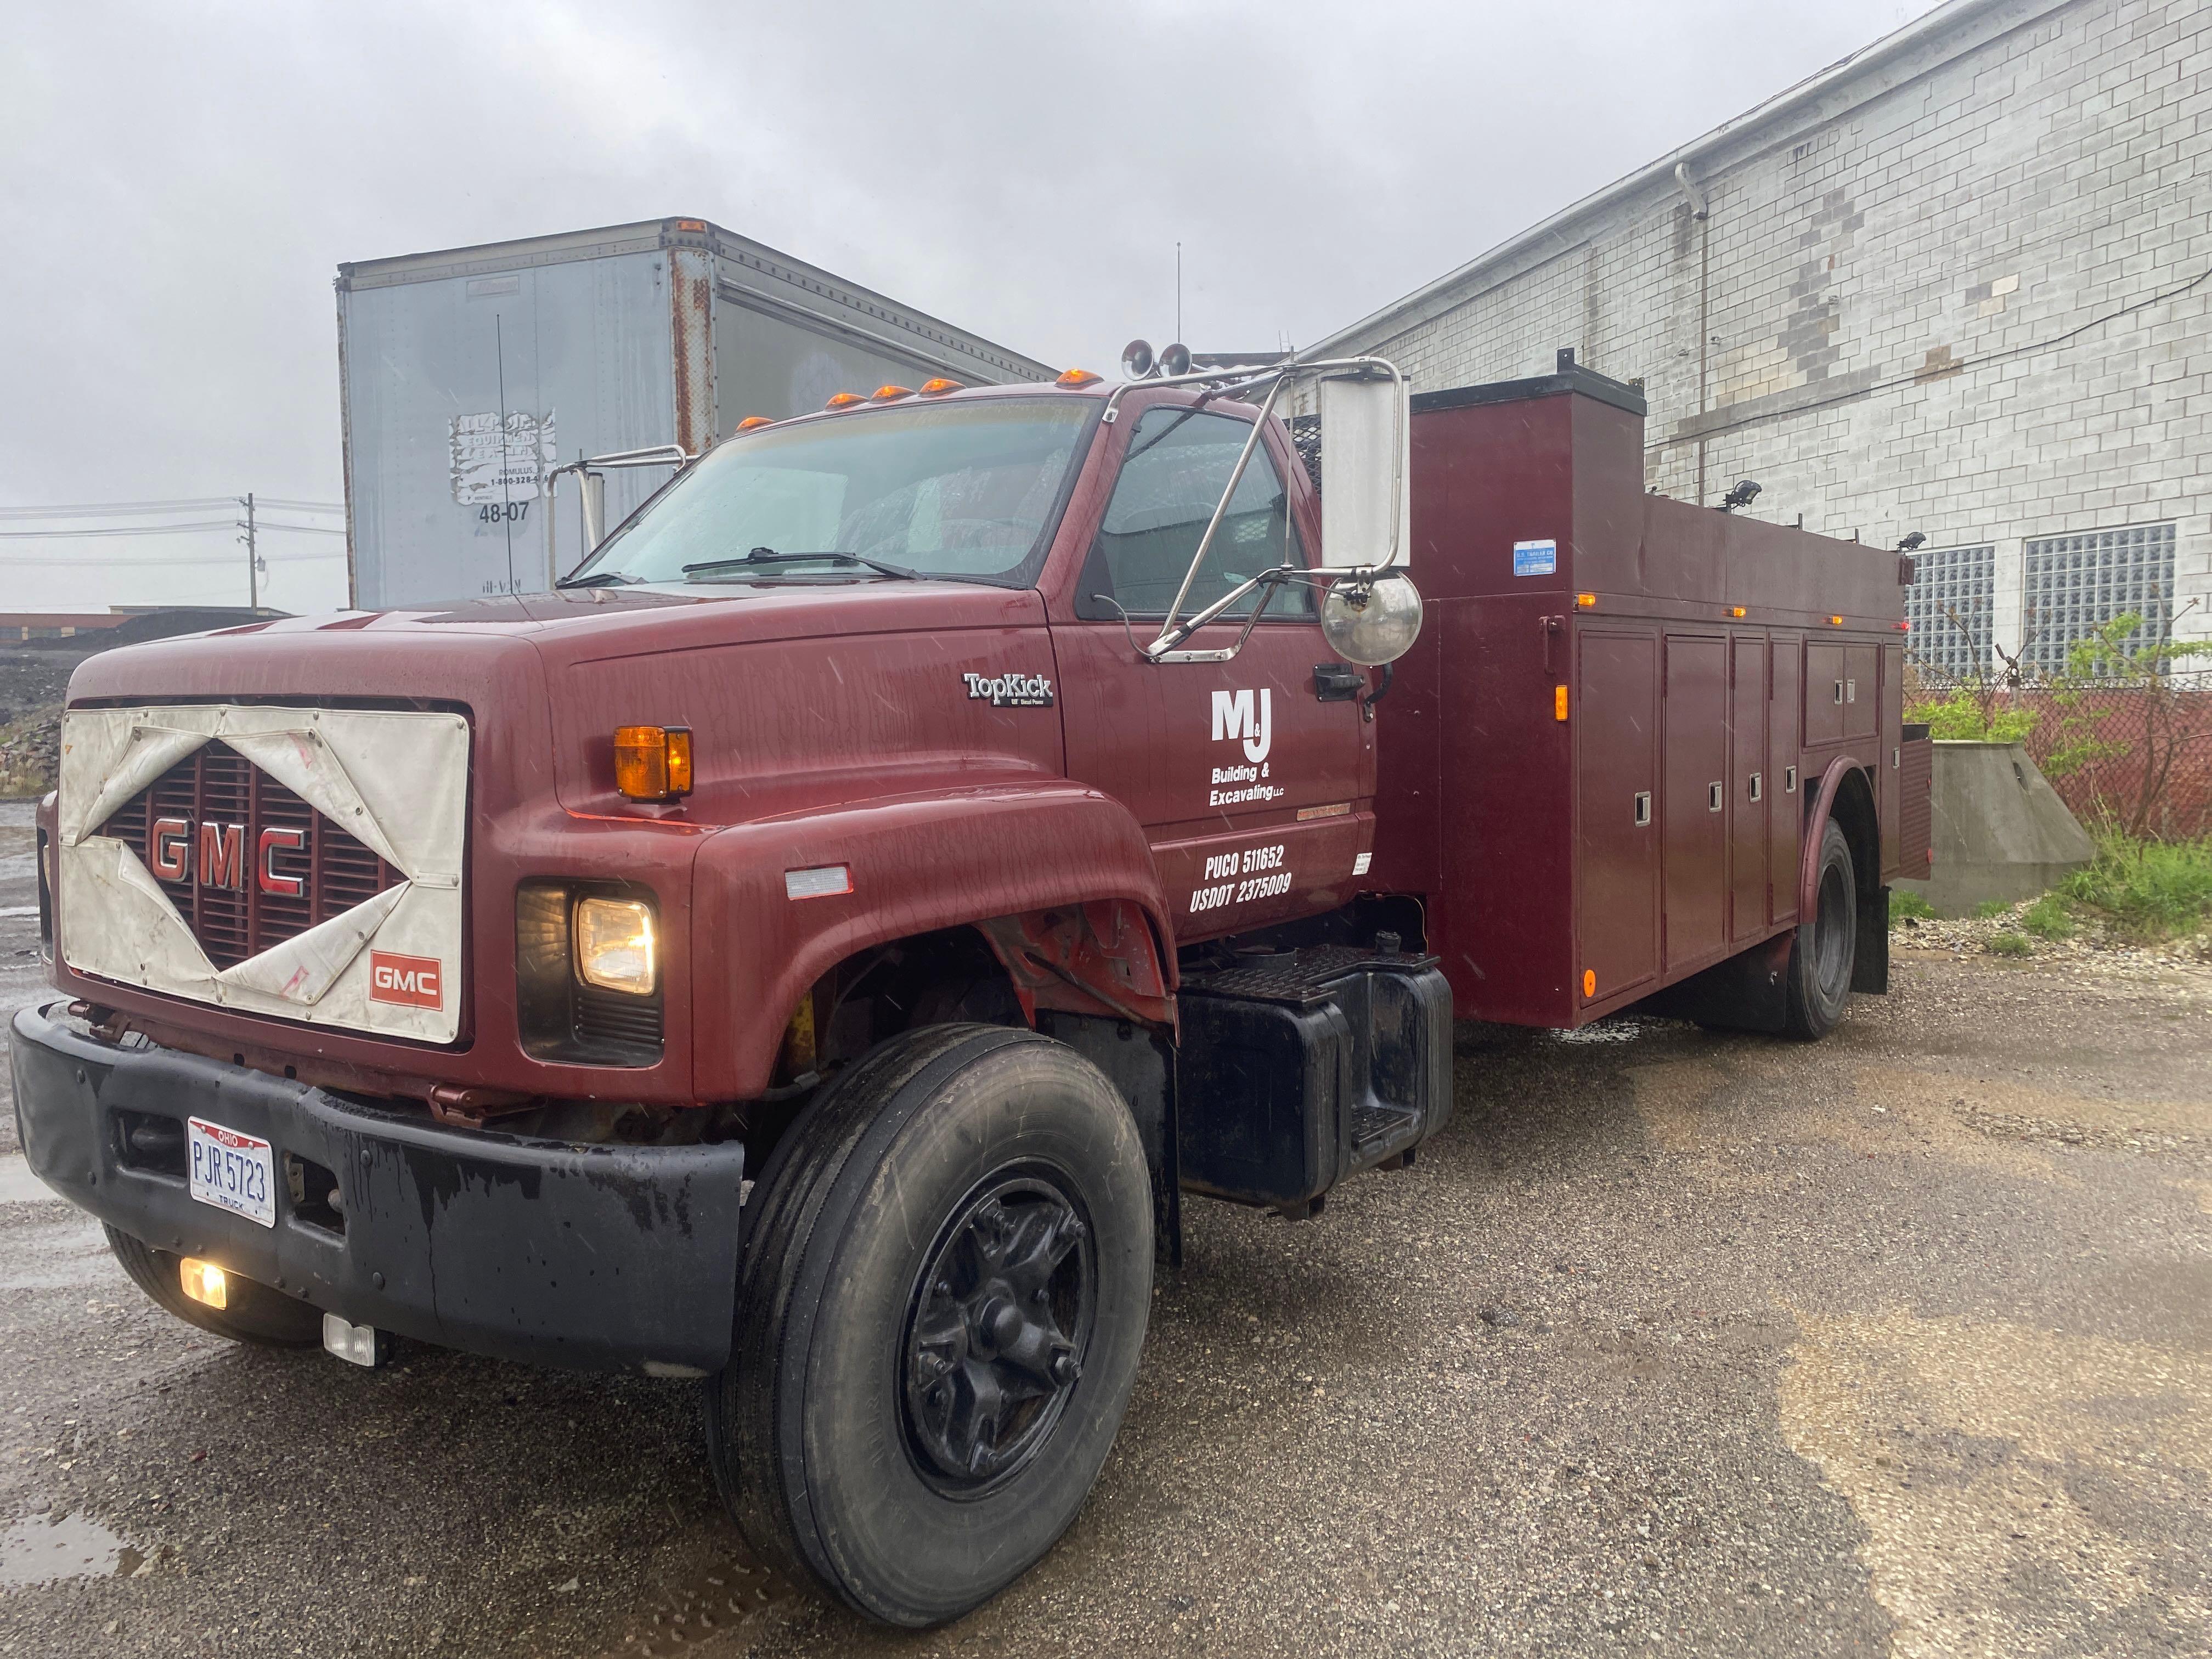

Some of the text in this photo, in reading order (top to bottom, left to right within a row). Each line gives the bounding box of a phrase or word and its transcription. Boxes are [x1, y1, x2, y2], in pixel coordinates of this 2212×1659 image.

[479, 501, 529, 523] 48-07
[963, 673, 1053, 706] TopKick
[1211, 762, 1269, 785] Building &
[1209, 785, 1273, 806] Excavating
[152, 818, 304, 898] GMC
[1204, 844, 1285, 881] PUCO 511652
[1189, 872, 1292, 913] USDOT 2375009
[374, 966, 438, 996] GMC
[218, 1130, 239, 1147] OHIO
[226, 1151, 265, 1203] 5723
[219, 1194, 245, 1211] TRUCK
